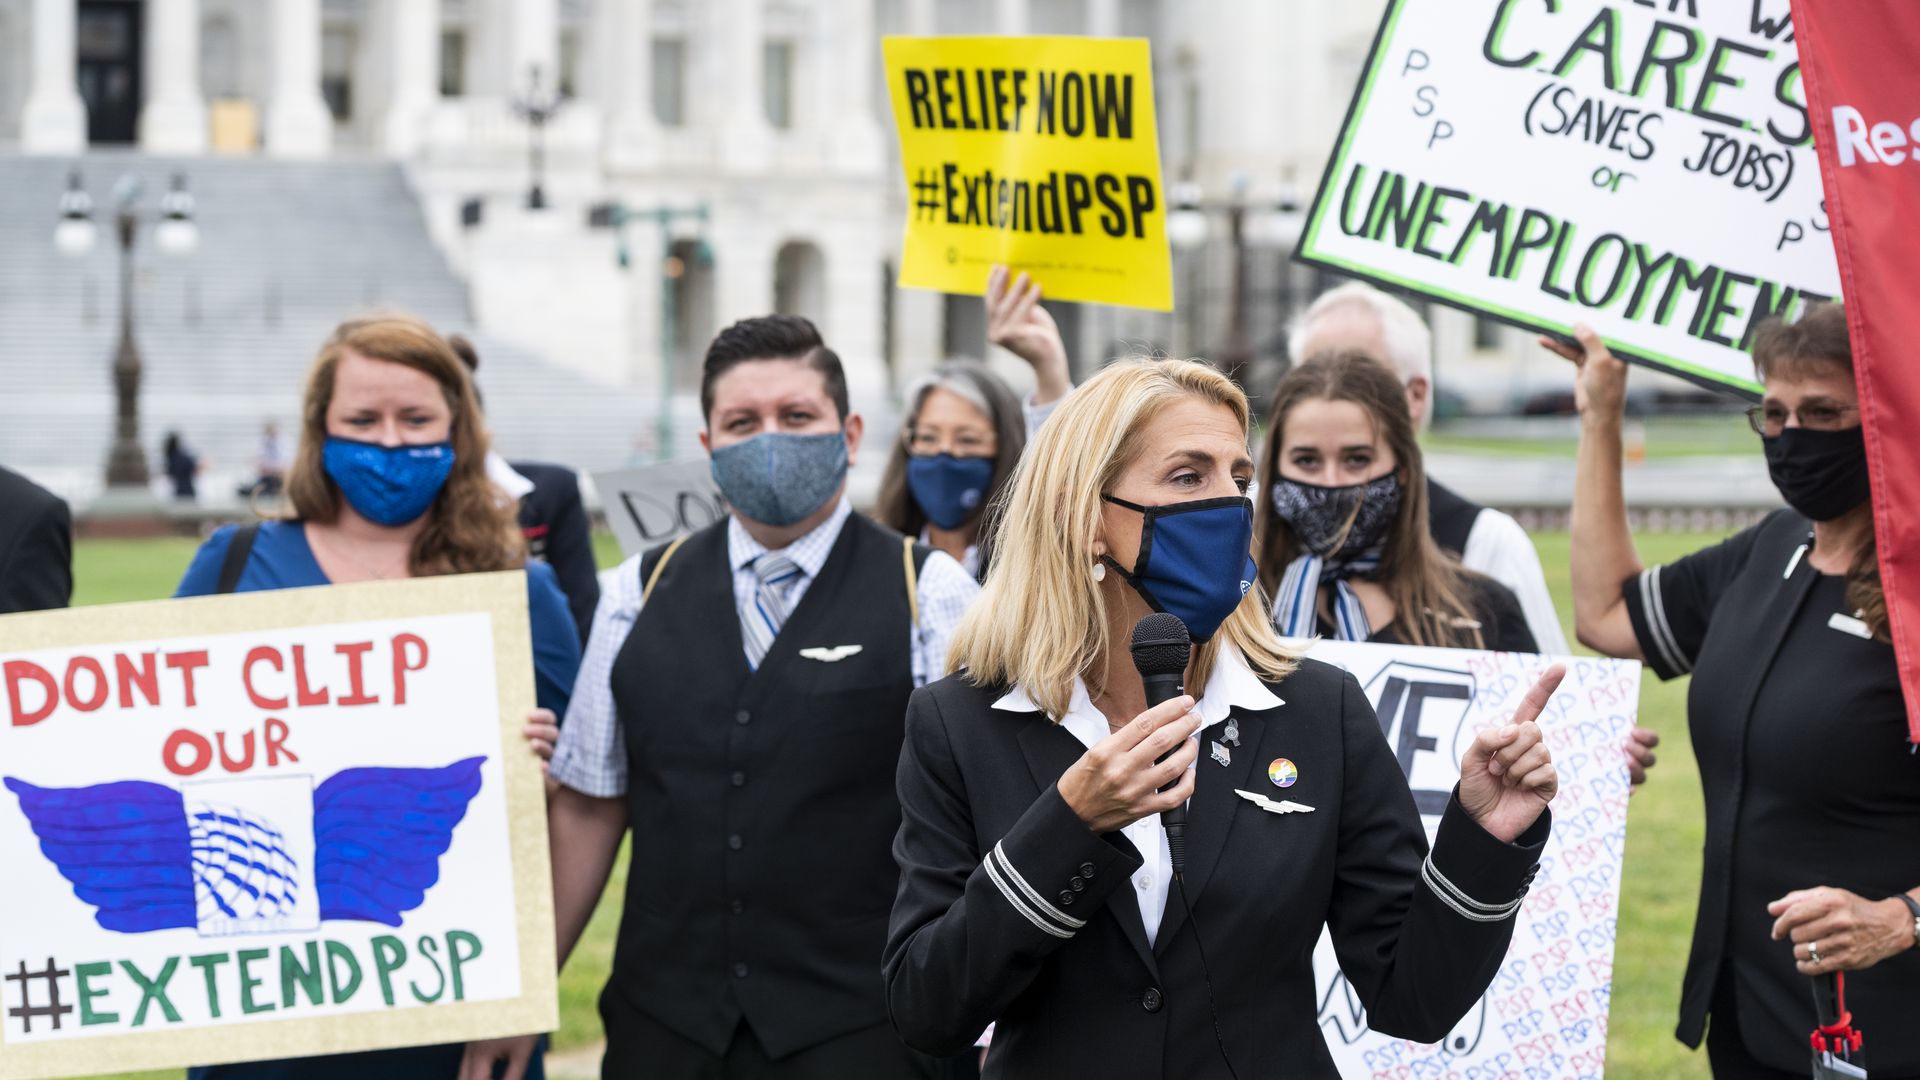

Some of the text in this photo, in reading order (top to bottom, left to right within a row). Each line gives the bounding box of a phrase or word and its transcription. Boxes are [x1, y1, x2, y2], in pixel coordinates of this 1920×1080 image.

[905, 68, 1134, 139] RELIEF NOW
[1482, 0, 1815, 148] CARES
[1524, 83, 1795, 203] (SAVES JOBS)
[1592, 166, 1638, 193] or
[913, 162, 1156, 240] #ExtendPSP
[3, 633, 430, 727] DONT CLIP
[1546, 692, 1577, 725] SP
[162, 718, 300, 776] OUR
[5, 929, 483, 1034] #EXTENDPSP
